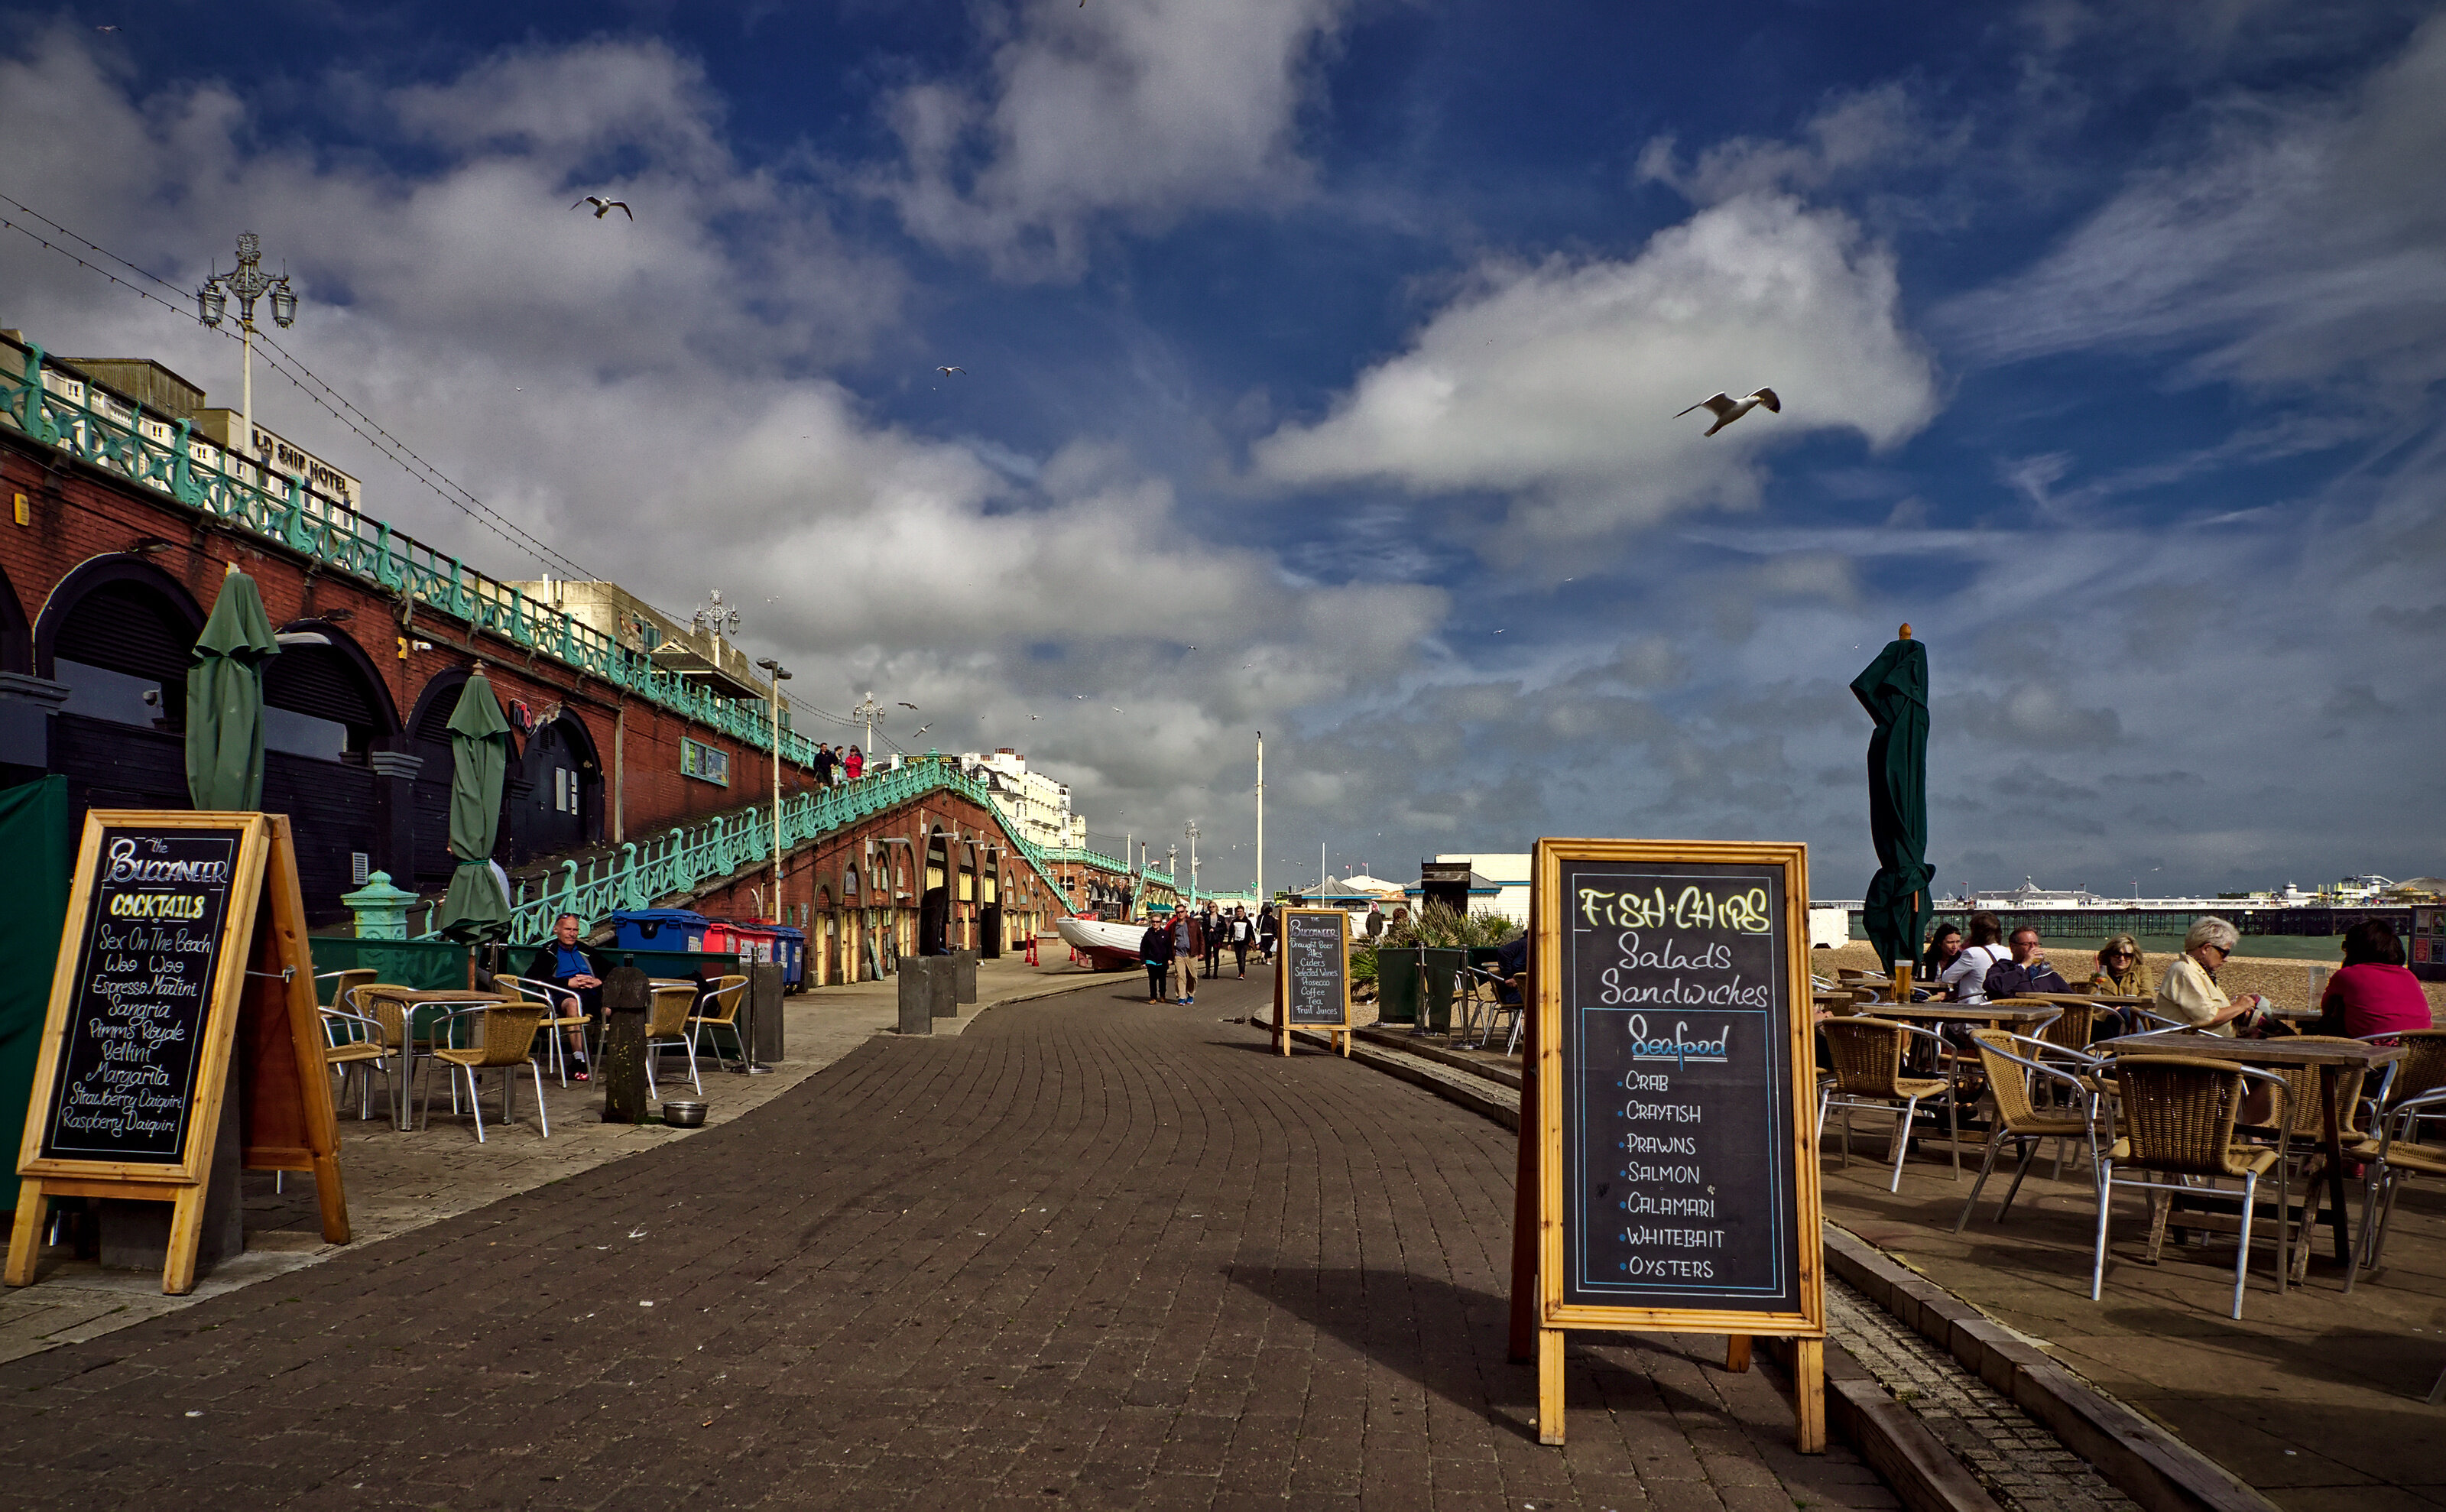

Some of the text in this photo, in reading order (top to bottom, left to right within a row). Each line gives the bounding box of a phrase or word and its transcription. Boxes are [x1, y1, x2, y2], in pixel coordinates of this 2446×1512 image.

[252, 429, 349, 494] LD SHIP HOTEL
[110, 894, 206, 919] COCKTAILS
[99, 923, 210, 953] Sex On The Beach
[1289, 939, 1333, 951] Draught Beer
[1307, 949, 1323, 958] Ales
[1617, 931, 1732, 969] Salads
[105, 953, 184, 973] Woo Woo
[1295, 966, 1338, 976] Selected Wines
[1300, 958, 1325, 967] Ciders
[92, 975, 198, 1000] Espresso Martini
[1301, 977, 1330, 986] Prosecco
[1301, 986, 1325, 997] Coffee
[1601, 968, 1769, 1007] Sandwiches
[109, 994, 171, 1026] Sangria
[1295, 1004, 1338, 1014] Fruit Juices
[89, 1017, 185, 1049] Pimms Royale
[1628, 1014, 1730, 1070] Seafood
[102, 1040, 151, 1062] Bellini
[86, 1061, 170, 1093] Margarita
[1626, 1070, 1669, 1092] CRAB
[70, 1082, 183, 1115] Strawberry Daiquiri
[62, 1106, 176, 1137] Raspberry Daiquiri
[1626, 1100, 1701, 1124] CRAYFISH
[1627, 1133, 1696, 1155] PRAWNS
[1628, 1161, 1700, 1184] SALMON
[1627, 1192, 1715, 1218] CALAMARI
[1627, 1225, 1725, 1248] WHITEBAIT
[1629, 1256, 1714, 1278] OYSTERS
